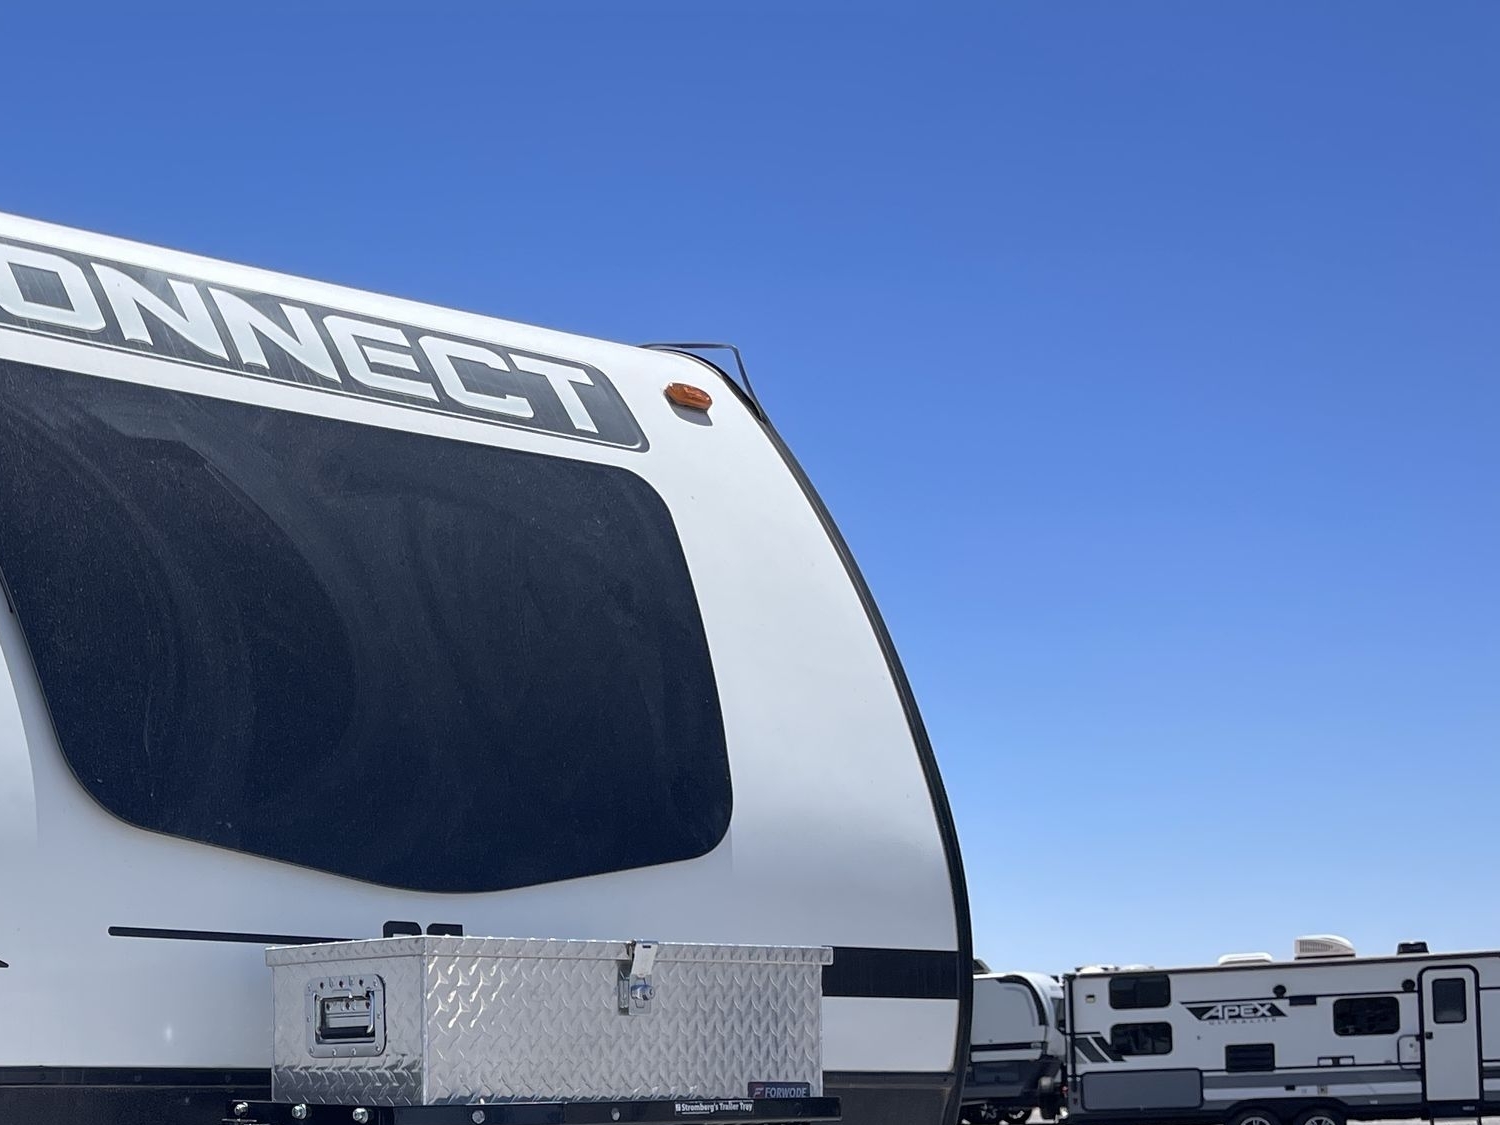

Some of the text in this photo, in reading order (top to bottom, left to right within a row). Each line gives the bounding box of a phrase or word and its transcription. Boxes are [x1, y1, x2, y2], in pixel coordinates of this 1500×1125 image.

[1201, 1003, 1272, 1020] APEX
[765, 1086, 807, 1098] FORWODE
[681, 1101, 753, 1113] Stromberg's Trailer Tray
